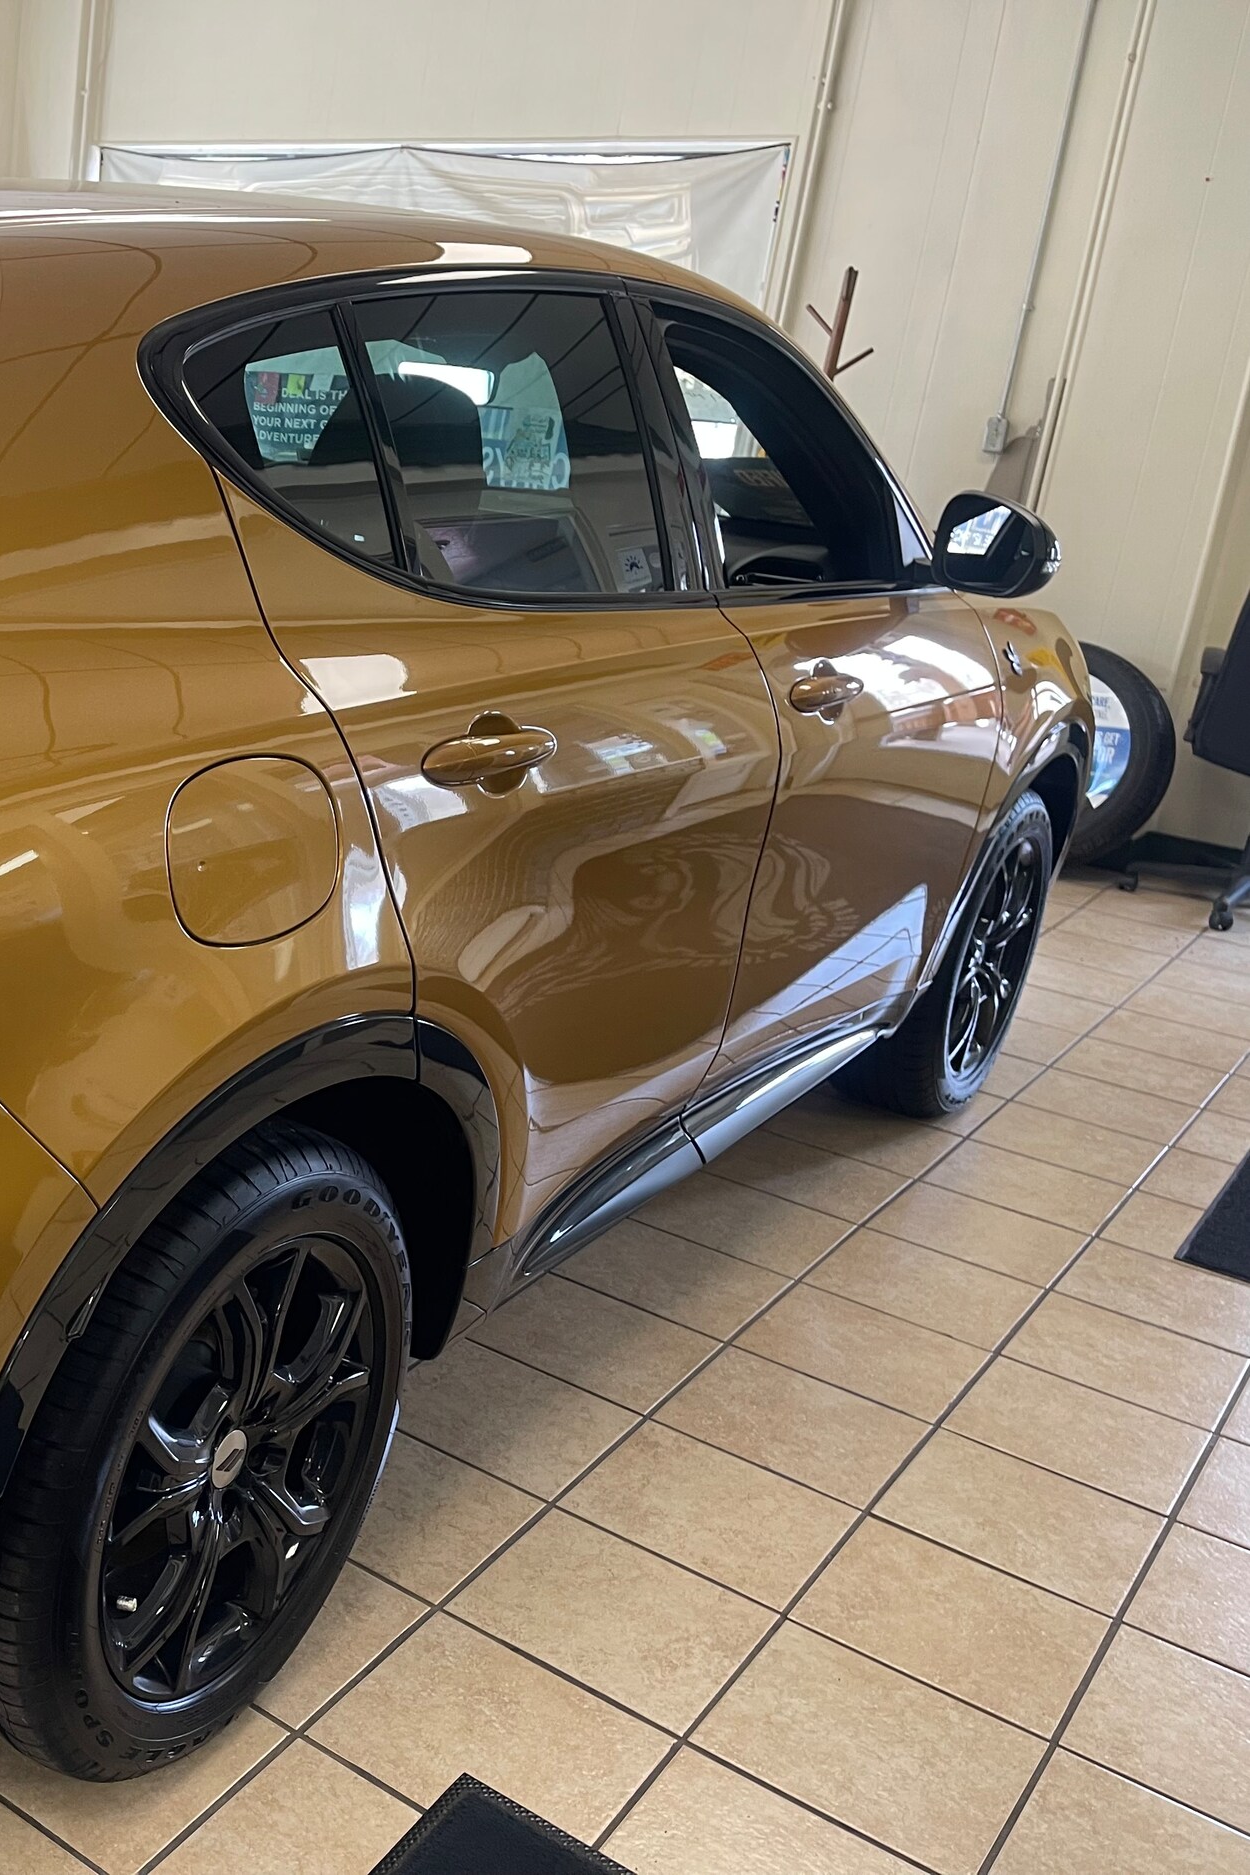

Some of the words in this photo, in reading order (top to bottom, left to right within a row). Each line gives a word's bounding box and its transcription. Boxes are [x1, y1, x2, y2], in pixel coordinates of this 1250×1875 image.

[330, 389, 348, 400] TH
[253, 402, 316, 415] BEGINNING
[319, 405, 338, 416] OF
[252, 415, 282, 428] YOUR
[284, 418, 317, 429] NEXT
